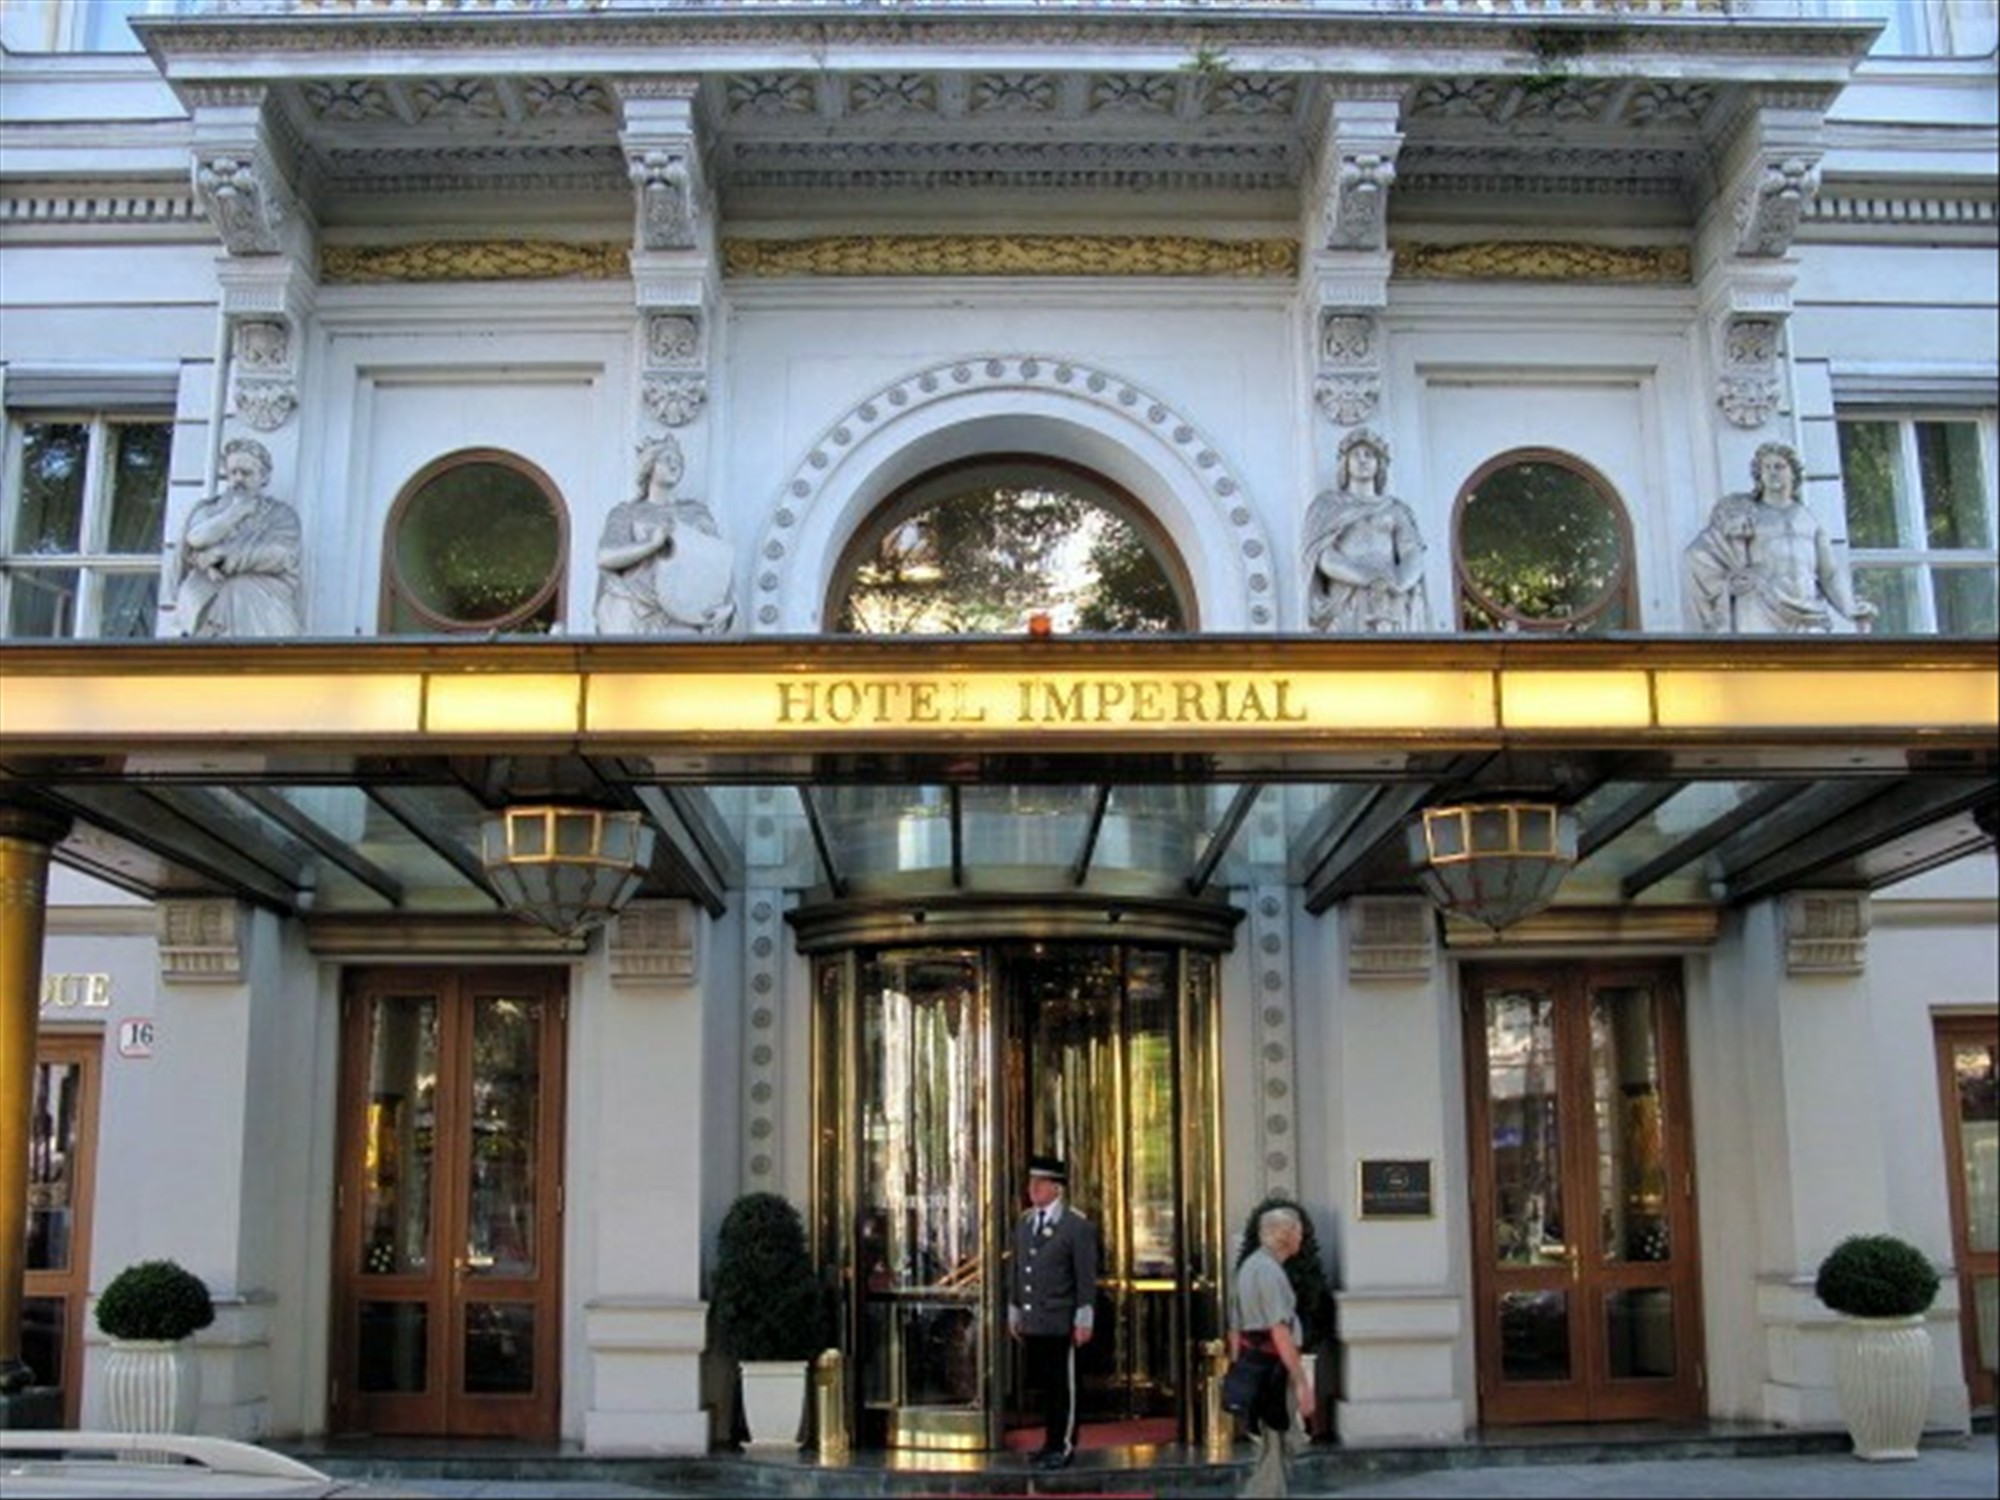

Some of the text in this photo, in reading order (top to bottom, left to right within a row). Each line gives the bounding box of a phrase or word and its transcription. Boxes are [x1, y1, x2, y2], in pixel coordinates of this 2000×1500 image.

[777, 680, 1308, 723] HOTEL IMPERIAL
[131, 1023, 154, 1044] 16
